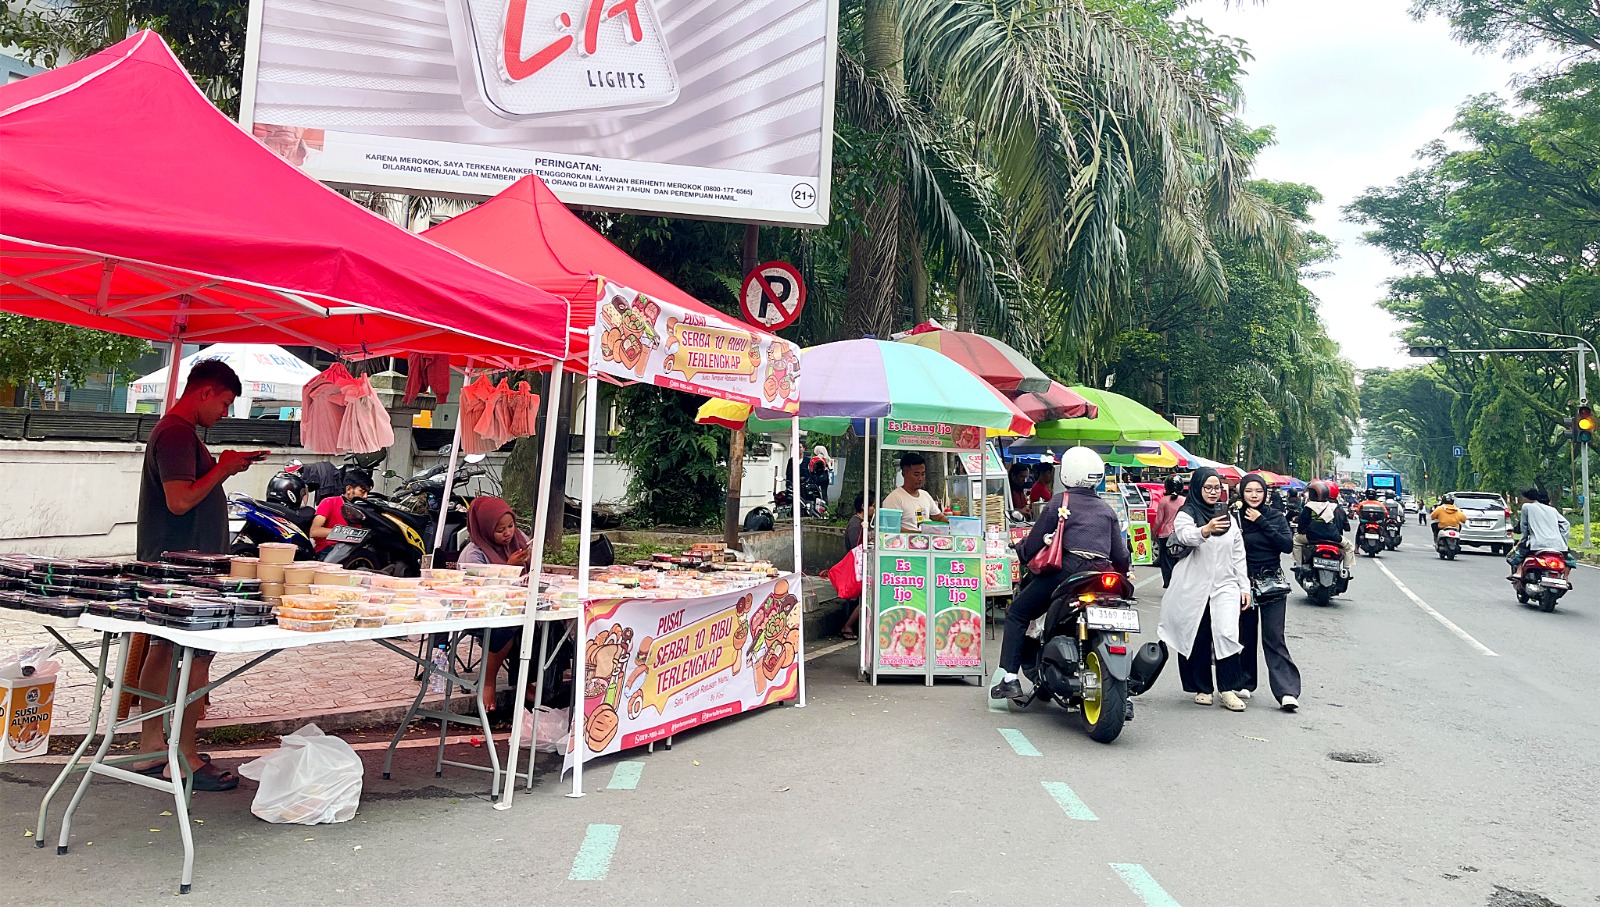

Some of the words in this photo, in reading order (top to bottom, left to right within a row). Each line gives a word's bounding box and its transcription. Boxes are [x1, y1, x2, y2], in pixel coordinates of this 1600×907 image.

[587, 70, 645, 88] LIGHTS
[365, 153, 398, 163] KARENA
[400, 156, 441, 167] MEROKOK,
[443, 161, 464, 169] SAYA
[466, 162, 501, 172] TERKENA
[502, 166, 533, 175] KANKER
[536, 169, 594, 181] TENGGOROKAN.
[595, 175, 629, 184] LAYANAN
[630, 178, 665, 187] BERHENTI
[666, 182, 702, 191] MEROKOK
[382, 163, 422, 173] DILARANG
[424, 167, 460, 177] MENJUAL
[462, 170, 478, 178] DAN
[480, 172, 516, 181] MEMBERI
[535, 158, 602, 172] PERINGATAN:
[552, 179, 578, 188] ORANG
[588, 183, 615, 191] BAWAH
[626, 185, 651, 194] TAHUN
[670, 190, 713, 199] PEREMPUAN
[794, 190, 814, 201] 21+
[682, 313, 707, 328] PUSAT
[681, 330, 711, 348] SERBA
[715, 335, 725, 349] 10
[727, 336, 749, 352] RIBU
[270, 354, 303, 369] BNI
[687, 351, 741, 370] TERLENGKAP
[142, 384, 157, 393] BNI
[261, 383, 276, 393] BNI
[888, 421, 900, 431] Es
[902, 422, 935, 435] Pisang
[937, 423, 951, 435] Ijo
[896, 560, 910, 571] Es
[950, 561, 965, 573] Es
[882, 573, 925, 589] Pisang
[937, 575, 978, 591] Pisang
[894, 588, 912, 602] Ijo
[949, 589, 967, 604] Ijo
[657, 608, 685, 636] PUSAT
[653, 637, 688, 668] SERBA
[694, 631, 705, 651] 10
[708, 616, 733, 645] RIBU
[657, 646, 722, 694] TERLENGKAP
[11, 713, 48, 726] ALMOND
[15, 707, 38, 717] SUSU
